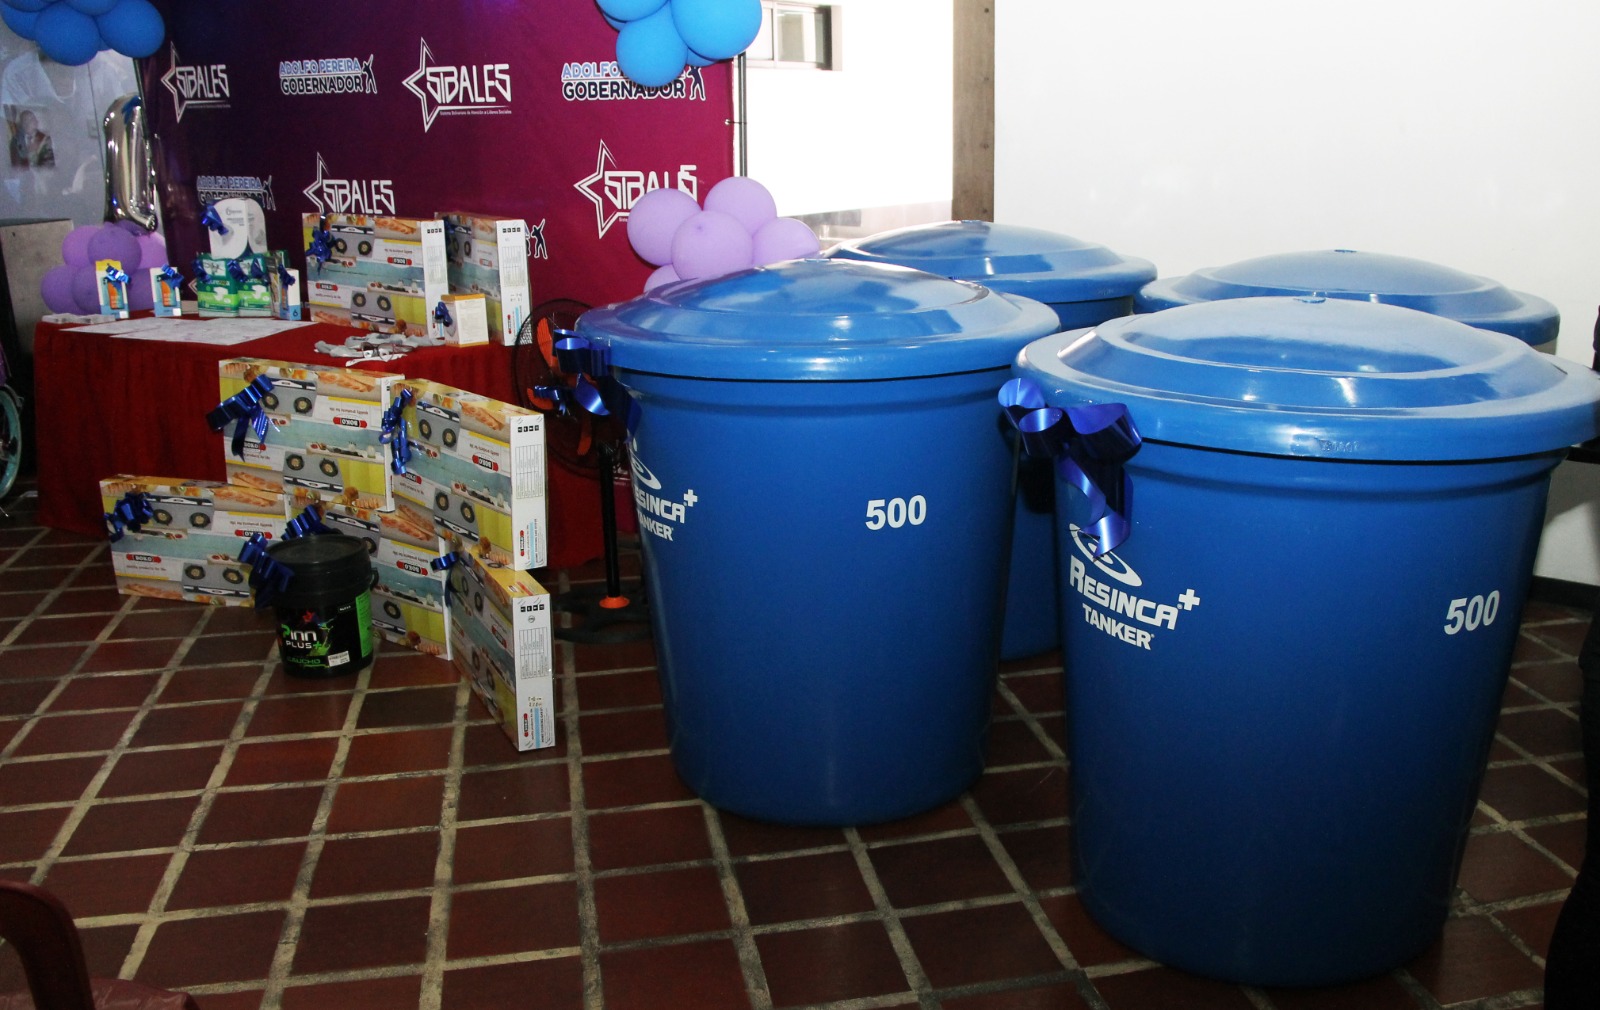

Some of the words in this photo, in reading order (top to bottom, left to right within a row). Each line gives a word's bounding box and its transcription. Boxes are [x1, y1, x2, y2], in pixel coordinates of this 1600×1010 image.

[279, 60, 318, 75] ADOLFO
[318, 57, 361, 74] PEREIRA
[562, 61, 620, 79] ADOLFO
[281, 75, 363, 94] GOBERNADOR
[228, 176, 262, 189] PEREIRA
[865, 495, 926, 530] 500
[1444, 590, 1499, 635] 500
[1082, 603, 1153, 650] TANKER
